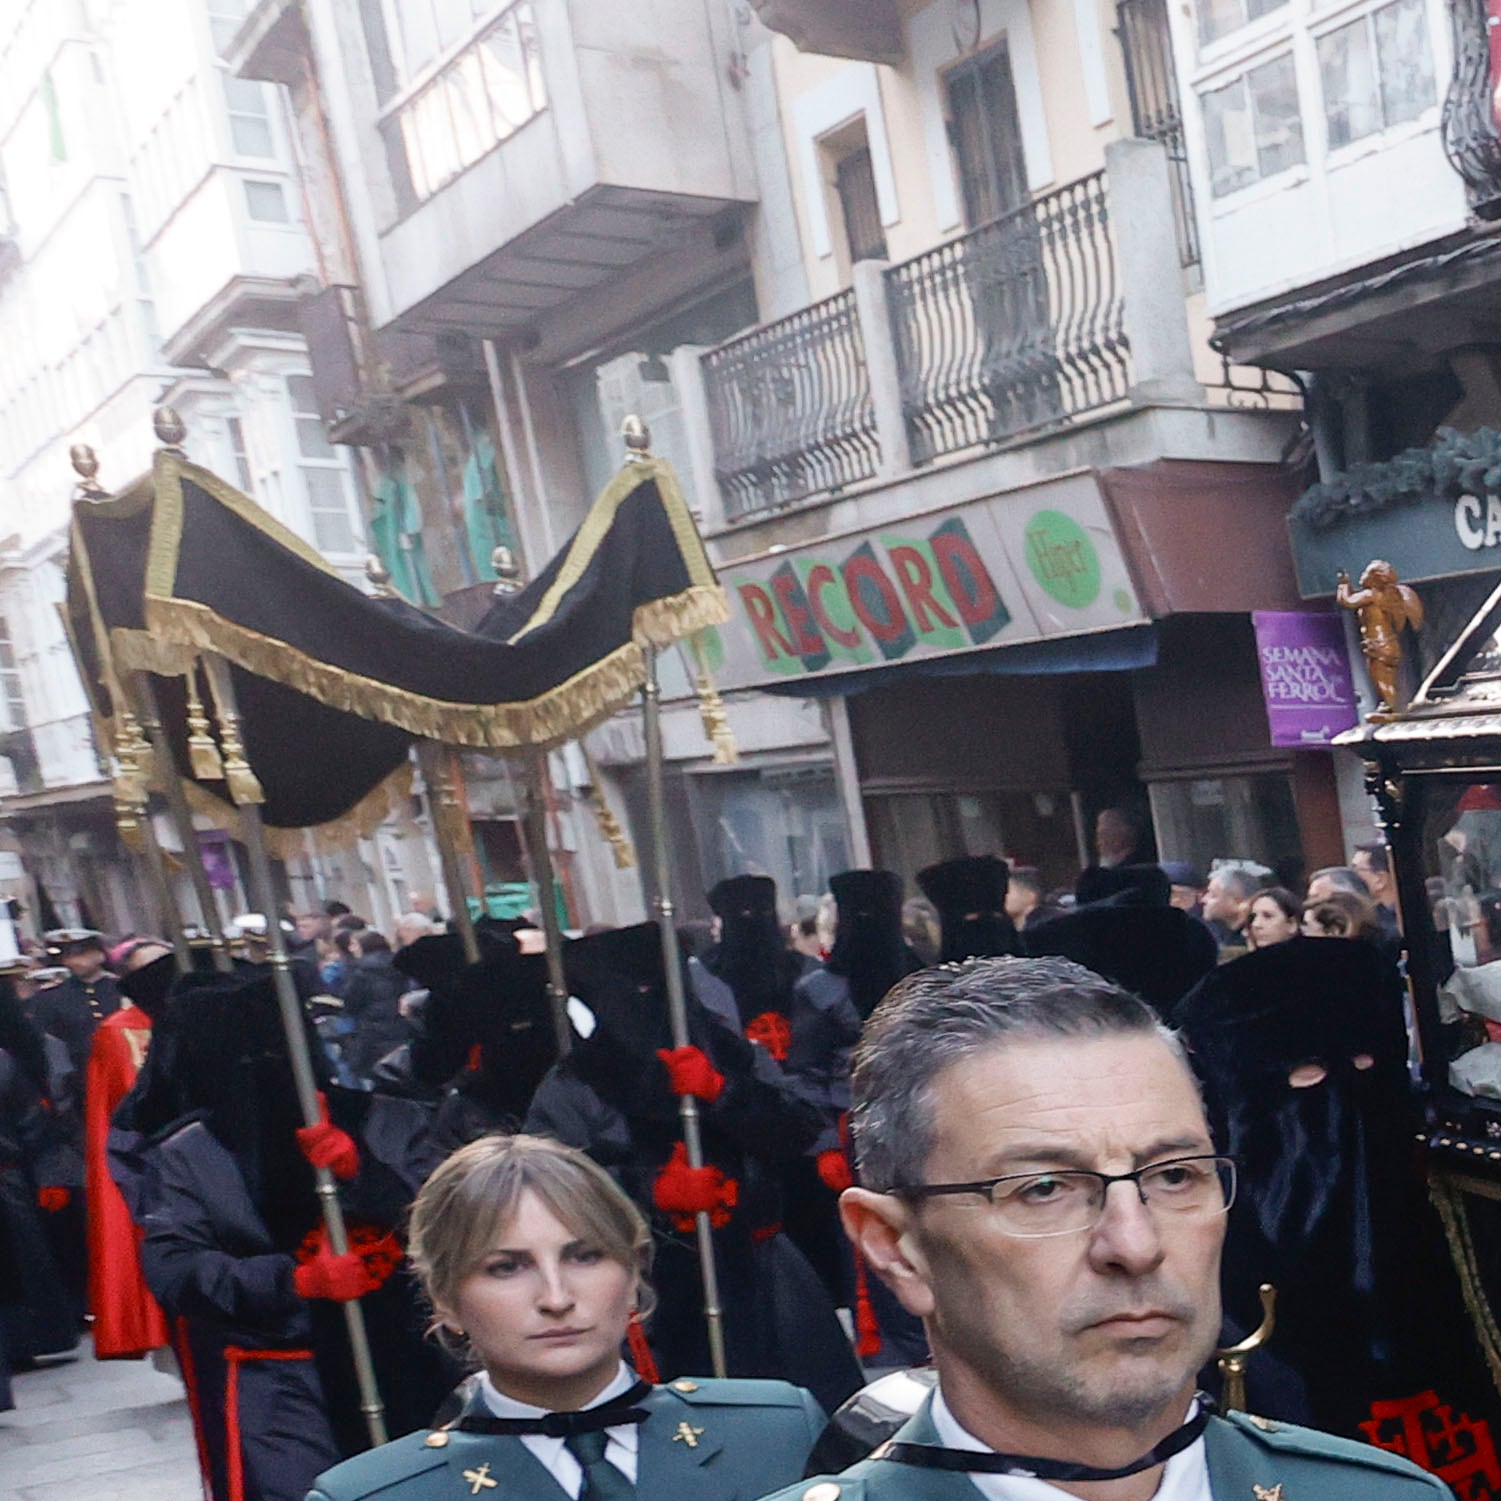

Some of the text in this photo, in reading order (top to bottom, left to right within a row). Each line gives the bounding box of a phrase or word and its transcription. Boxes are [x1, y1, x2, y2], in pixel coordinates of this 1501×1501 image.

[737, 533, 999, 660] RECORD
[1262, 646, 1341, 664] SEMANA
[1265, 663, 1329, 687] SANTA
[1268, 681, 1345, 703] FERROL
